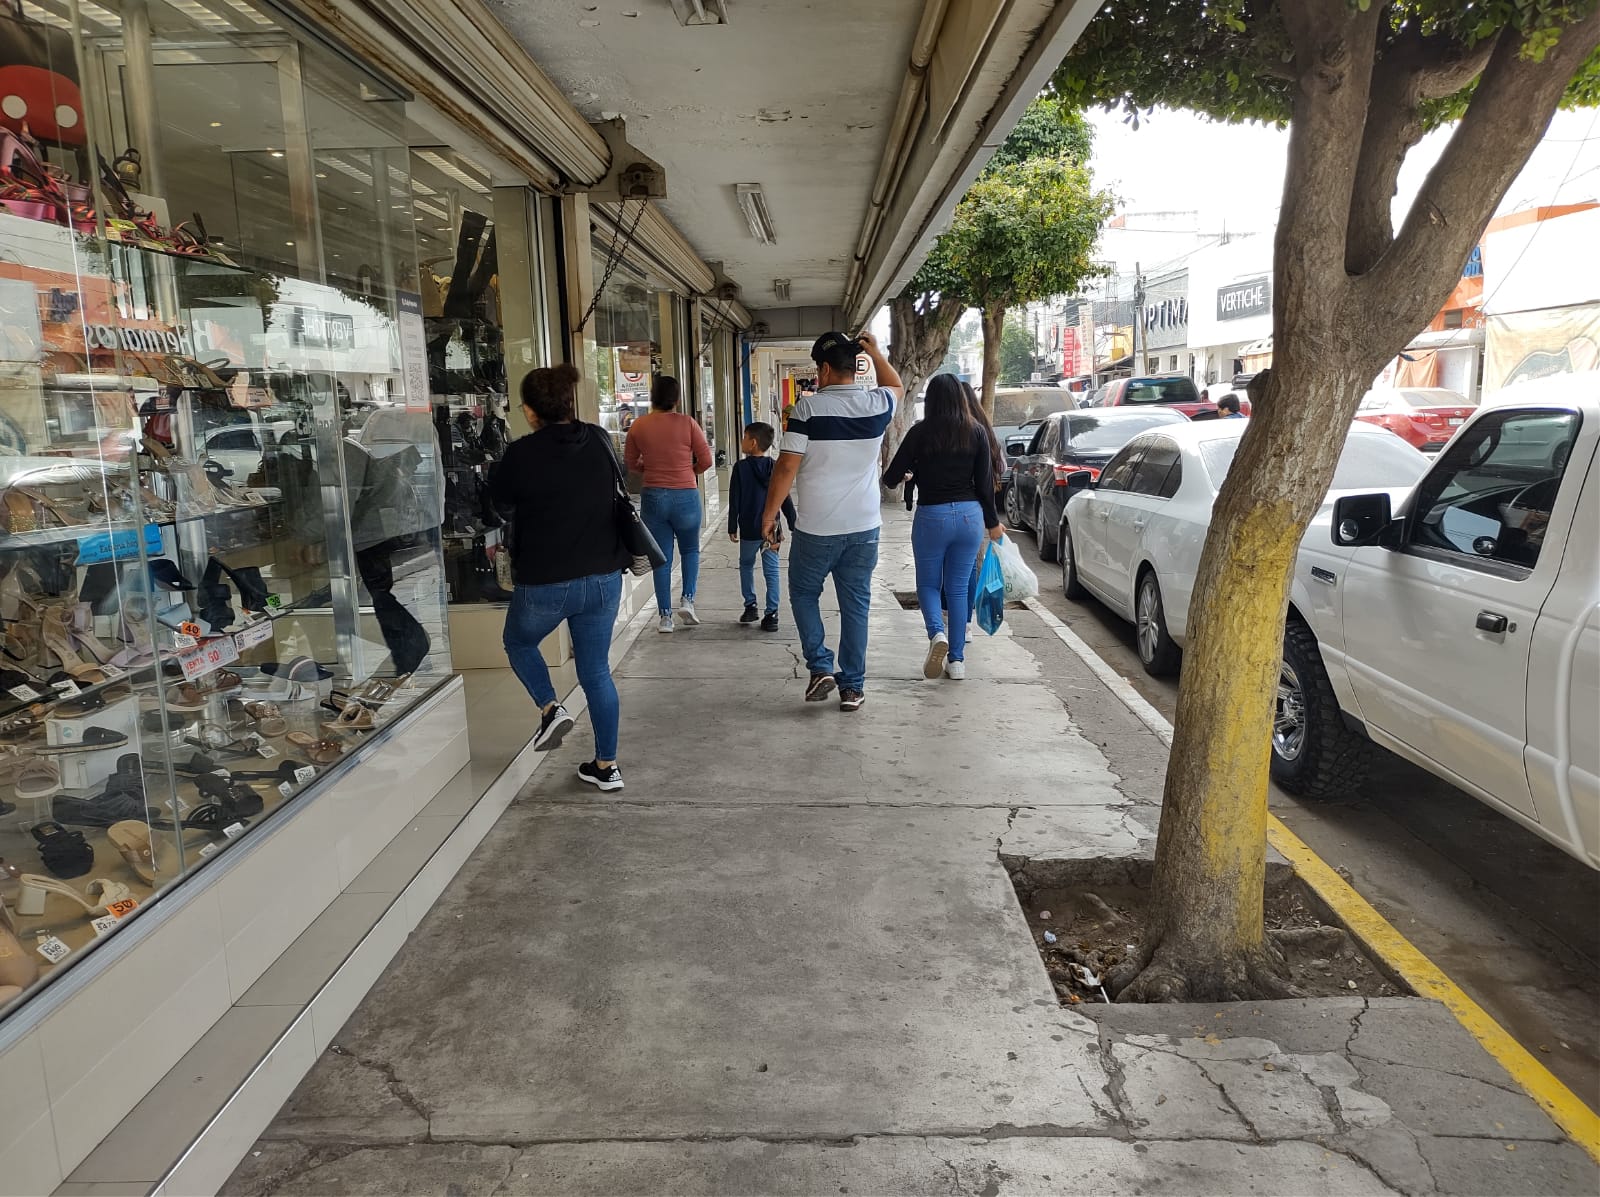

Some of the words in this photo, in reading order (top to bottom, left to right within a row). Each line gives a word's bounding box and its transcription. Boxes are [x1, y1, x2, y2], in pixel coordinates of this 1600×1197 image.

[1220, 285, 1264, 313] VERTICHE
[857, 359, 866, 371] E
[185, 625, 199, 634] 40
[184, 656, 205, 671] VENTA
[207, 649, 220, 663] 50
[112, 900, 133, 912] 50
